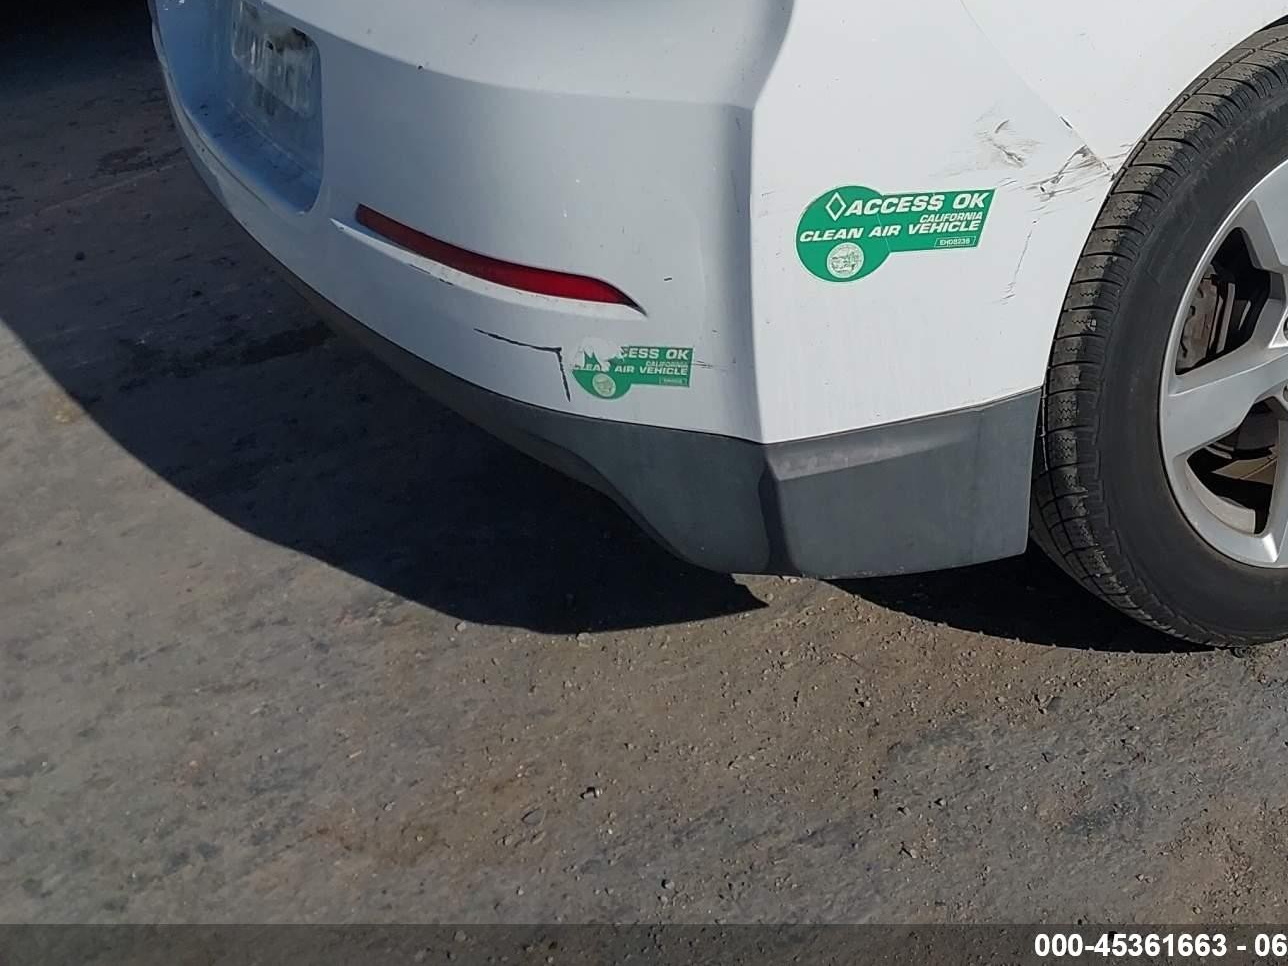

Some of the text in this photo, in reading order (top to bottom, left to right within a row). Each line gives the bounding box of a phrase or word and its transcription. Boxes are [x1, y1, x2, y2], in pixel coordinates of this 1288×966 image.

[845, 193, 989, 216] ACCESS OK
[919, 211, 983, 224] CALIFORNIA
[800, 220, 982, 242] CLEAN AIR VEHICLE
[666, 349, 688, 360] OK
[614, 365, 635, 374] AIR
[640, 367, 687, 375] VEHICLE
